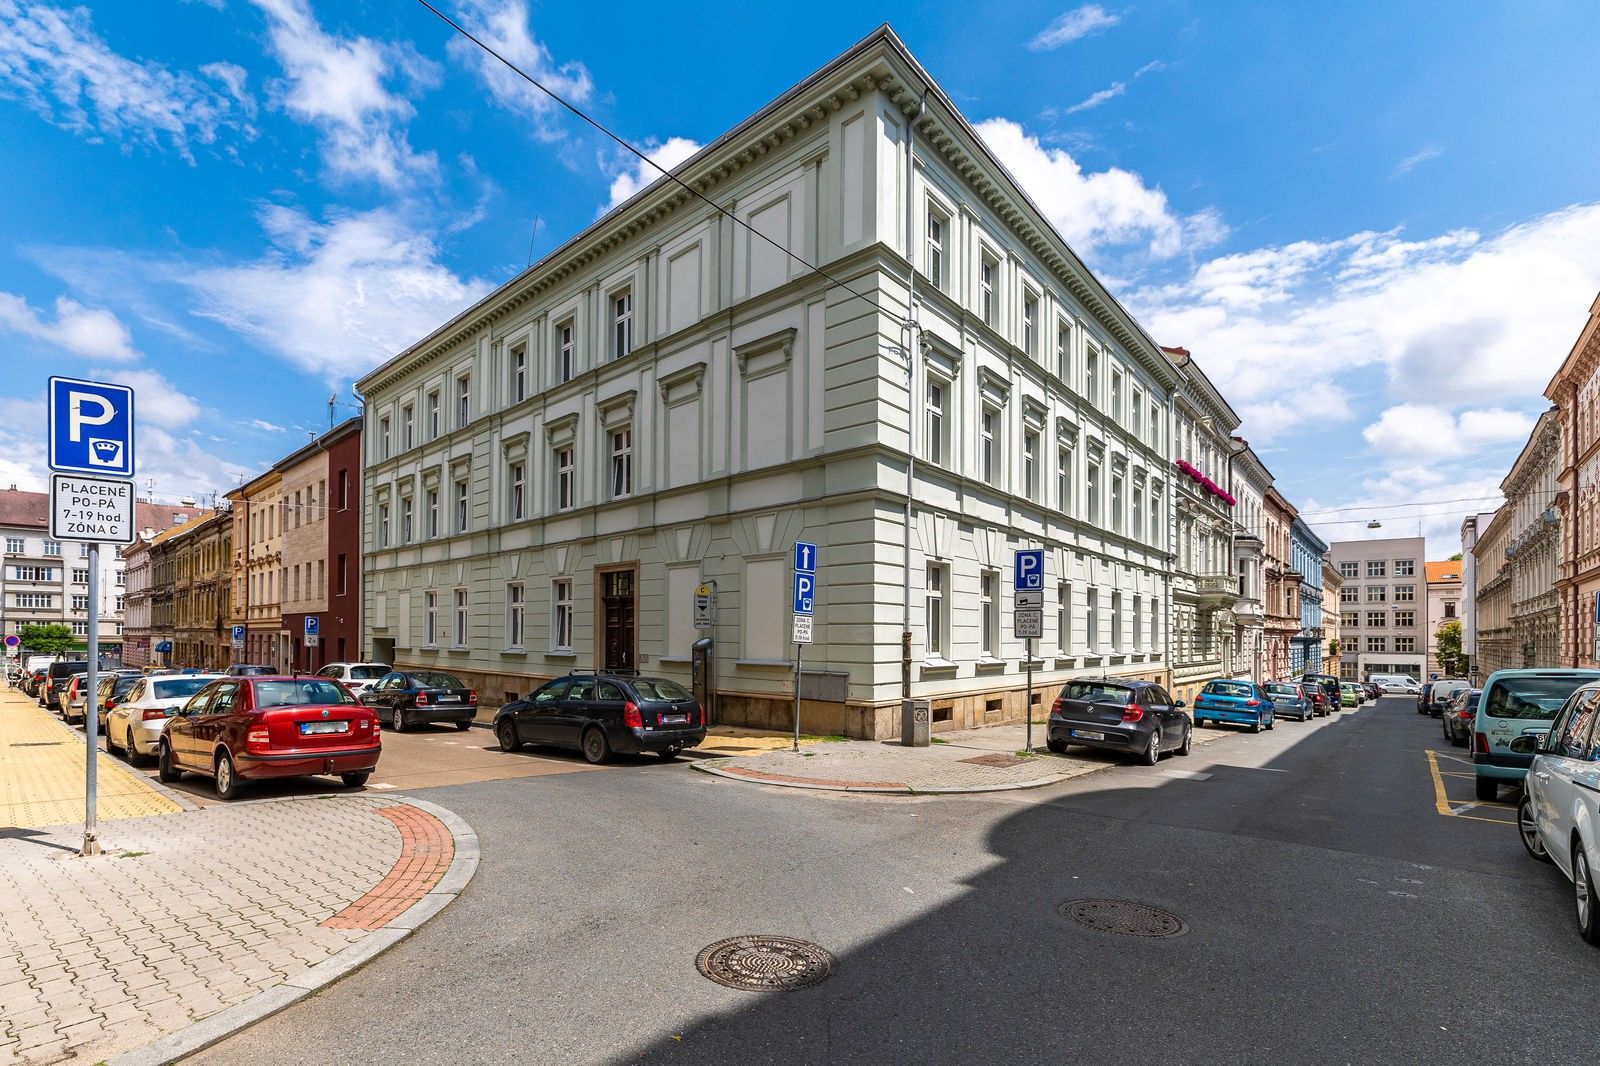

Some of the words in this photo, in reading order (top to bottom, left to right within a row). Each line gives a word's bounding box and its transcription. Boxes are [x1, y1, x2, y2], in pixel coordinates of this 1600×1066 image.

[69, 390, 115, 443] P
[61, 482, 126, 498] PLACENÉ
[72, 496, 116, 510] PO-PÁ
[63, 509, 94, 521] 7-19
[97, 510, 125, 523] hod.
[67, 521, 106, 535] ZÓNA
[109, 525, 118, 535] C
[1020, 555, 1037, 578] P
[798, 577, 811, 600] P
[307, 618, 316, 629] P
[235, 627, 242, 635] P
